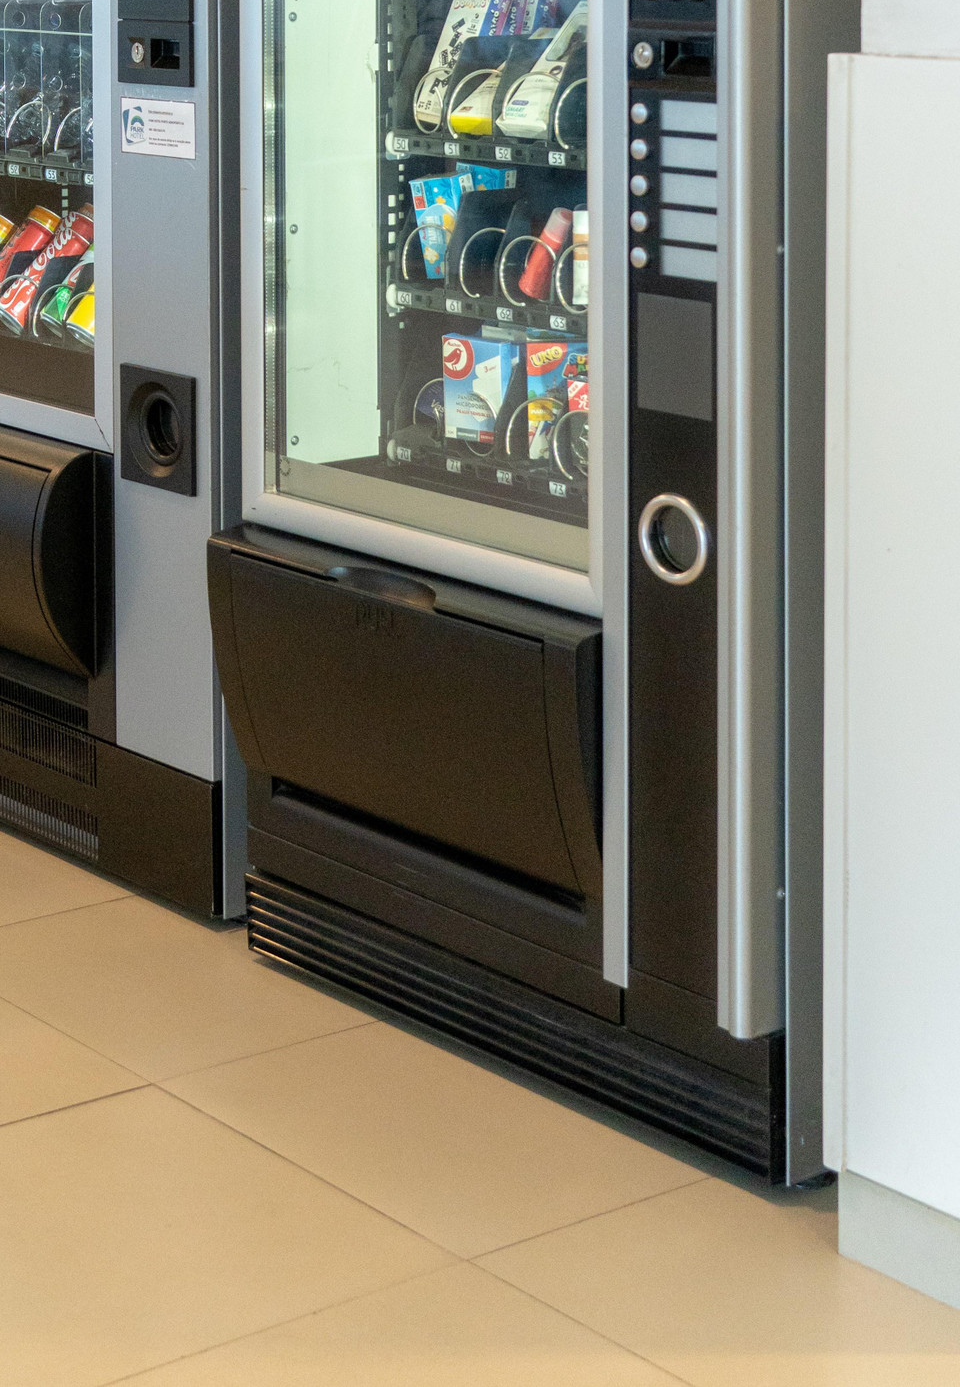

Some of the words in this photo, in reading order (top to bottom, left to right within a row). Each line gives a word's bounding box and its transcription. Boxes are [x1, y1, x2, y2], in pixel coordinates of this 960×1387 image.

[130, 126, 144, 134] PARK
[395, 139, 406, 151] 50
[448, 143, 458, 155] 51
[498, 148, 509, 160] 52
[551, 153, 563, 164] 53
[10, 165, 20, 174] 52
[47, 170, 57, 180] 53
[399, 293, 410, 304] 60
[449, 300, 460, 312] 61
[499, 309, 511, 321] 62
[552, 317, 565, 329] 63
[529, 345, 564, 368] UNO
[399, 449, 410, 460] 70
[449, 460, 460, 471] 71
[498, 471, 510, 483] 72
[551, 483, 564, 495] 73
